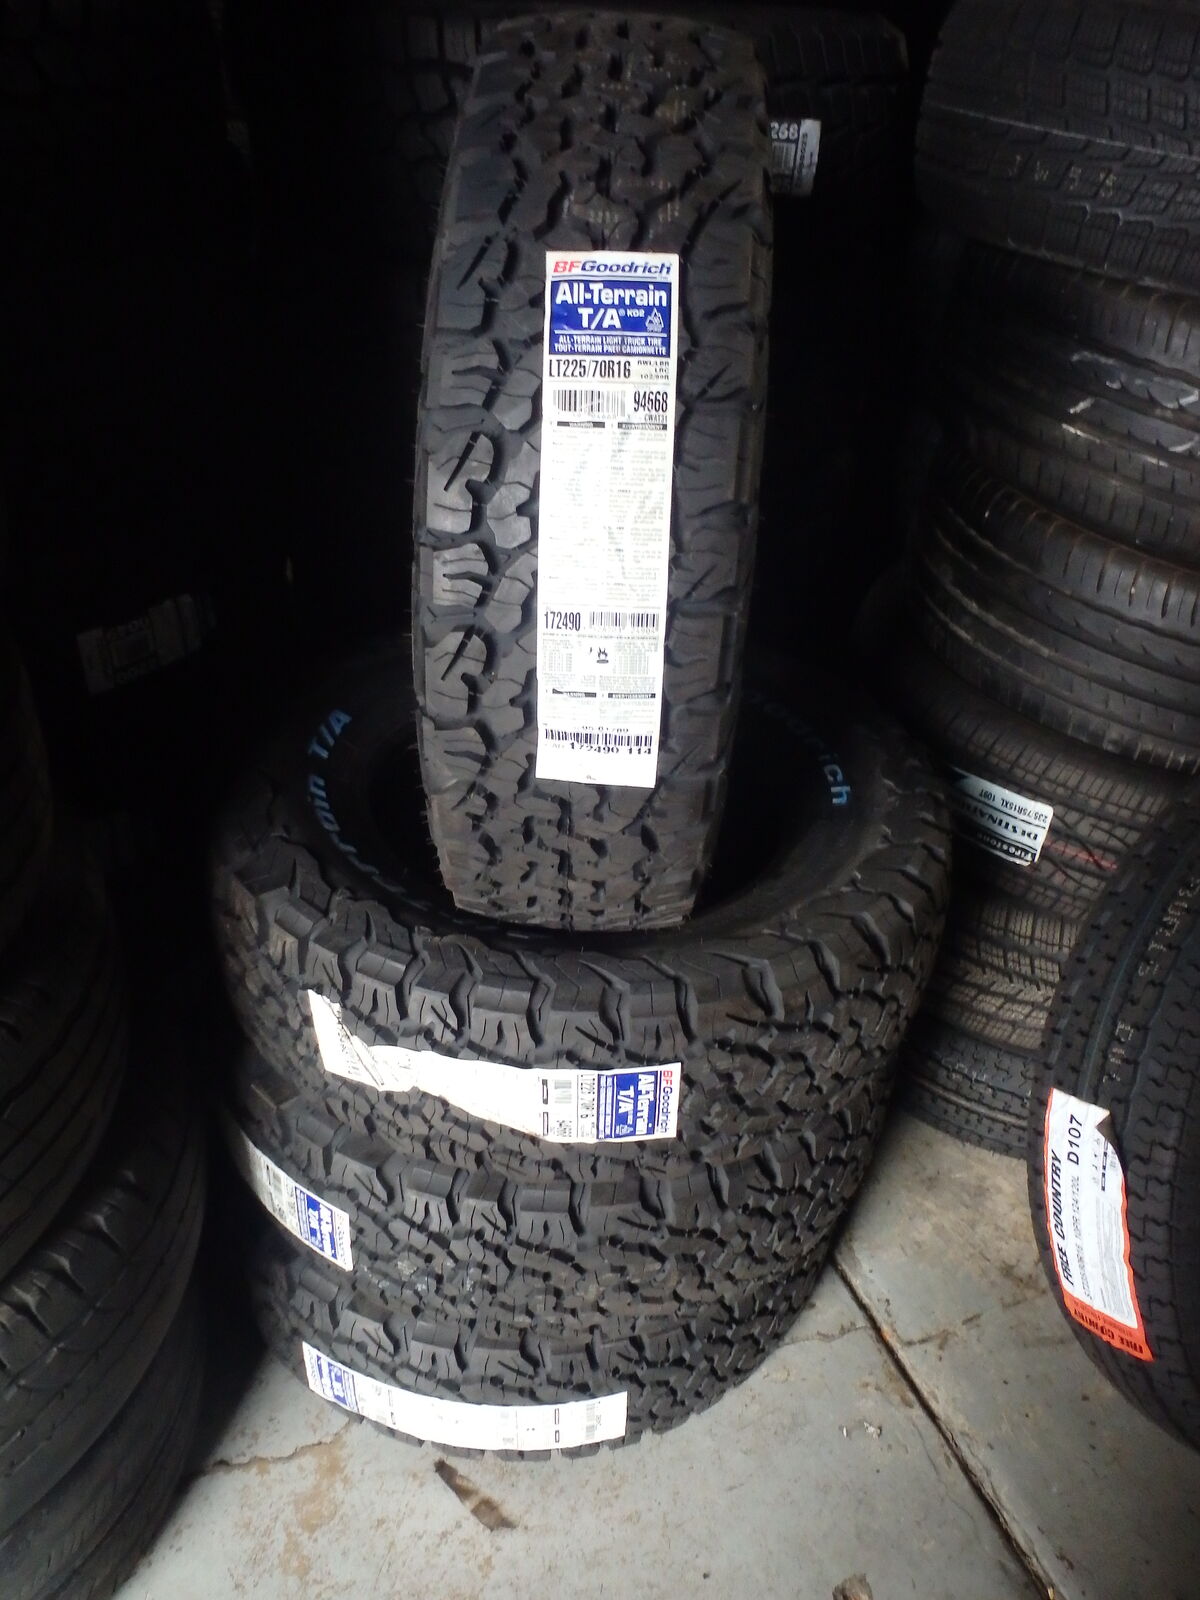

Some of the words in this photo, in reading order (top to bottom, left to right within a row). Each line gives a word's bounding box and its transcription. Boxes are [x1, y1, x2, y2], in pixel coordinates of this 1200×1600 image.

[553, 260, 672, 275] BFGoodrich
[555, 281, 667, 307] All-Terrain
[548, 359, 631, 379] LT225/70R16
[633, 390, 668, 413] 94668
[543, 611, 581, 632] 172490
[307, 708, 353, 760] T/A
[661, 1070, 674, 1134] BFGoodrich
[1066, 1113, 1083, 1166] D107
[1051, 1148, 1066, 1241] COUNTRY
[1057, 1243, 1074, 1286] FREE
